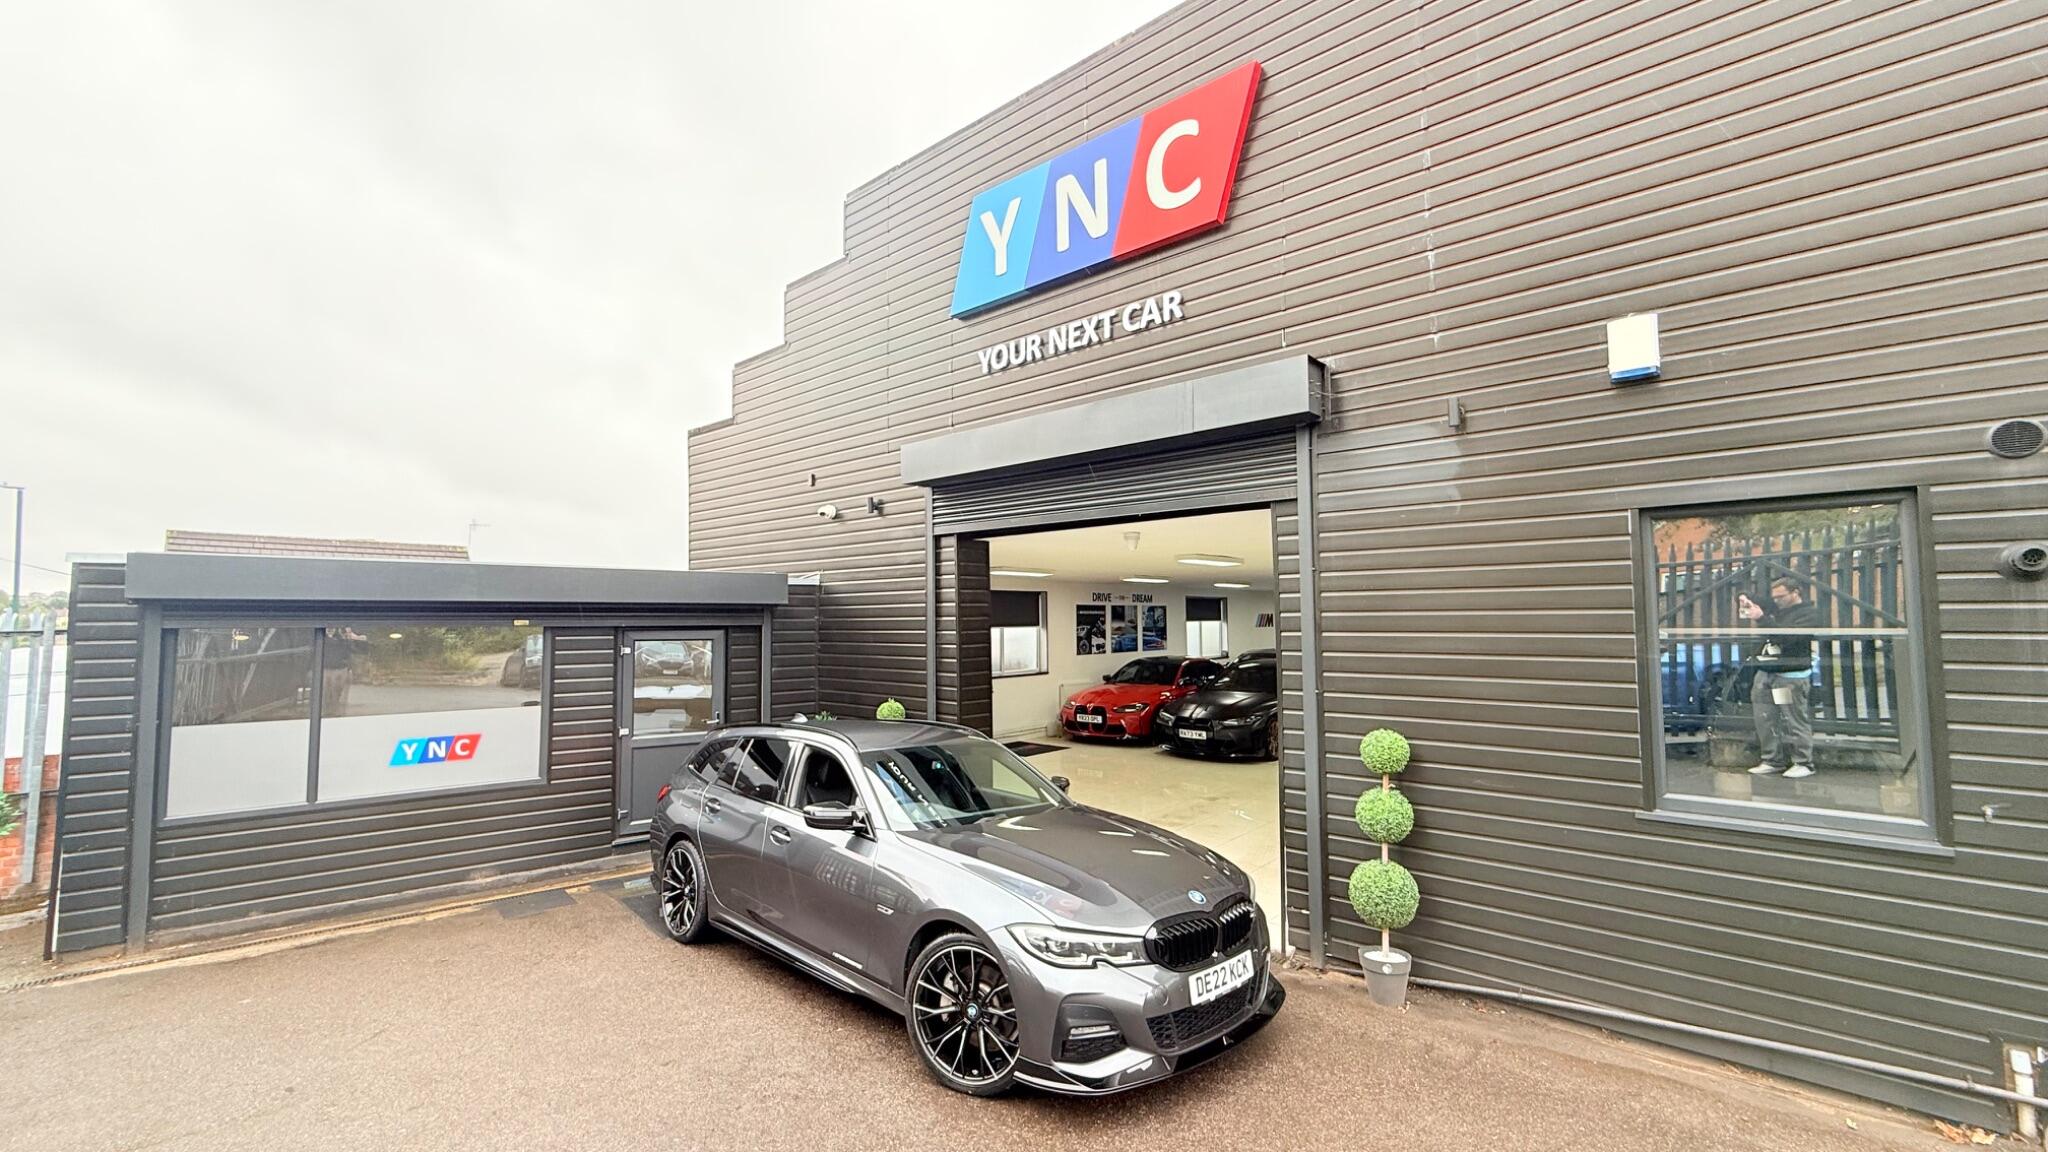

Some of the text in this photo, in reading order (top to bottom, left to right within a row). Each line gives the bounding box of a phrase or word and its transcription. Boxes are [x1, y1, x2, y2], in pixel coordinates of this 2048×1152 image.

[980, 118, 1201, 276] YNC
[977, 291, 1184, 374] YOUR NEXT CAR
[1092, 592, 1112, 602] DRIVE
[1132, 594, 1153, 603] DREAM
[401, 738, 470, 761] YNC
[1196, 954, 1249, 997] DE22 KCK
